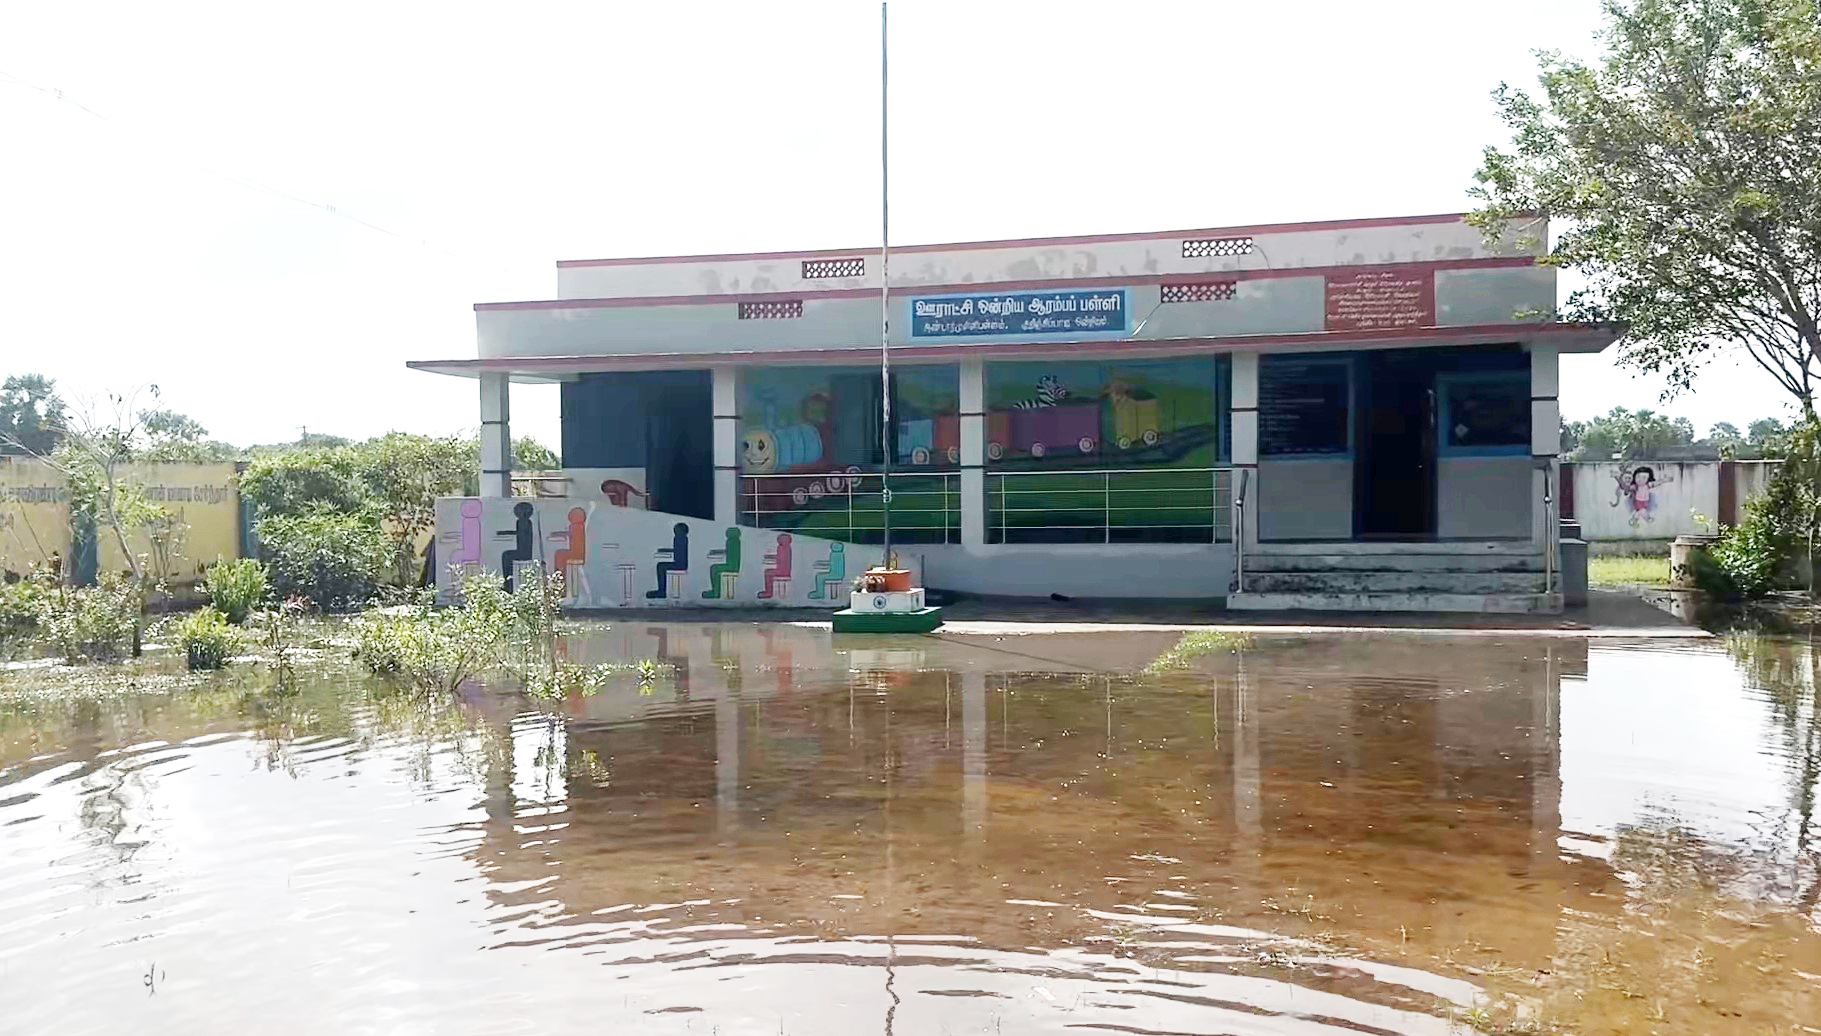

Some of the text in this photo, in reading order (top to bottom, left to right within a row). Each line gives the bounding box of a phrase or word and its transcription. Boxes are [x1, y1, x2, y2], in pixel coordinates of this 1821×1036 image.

[915, 294, 1121, 318] ஊராட்சி ஒன்றிய ஆரம்பப் பள்ளி
